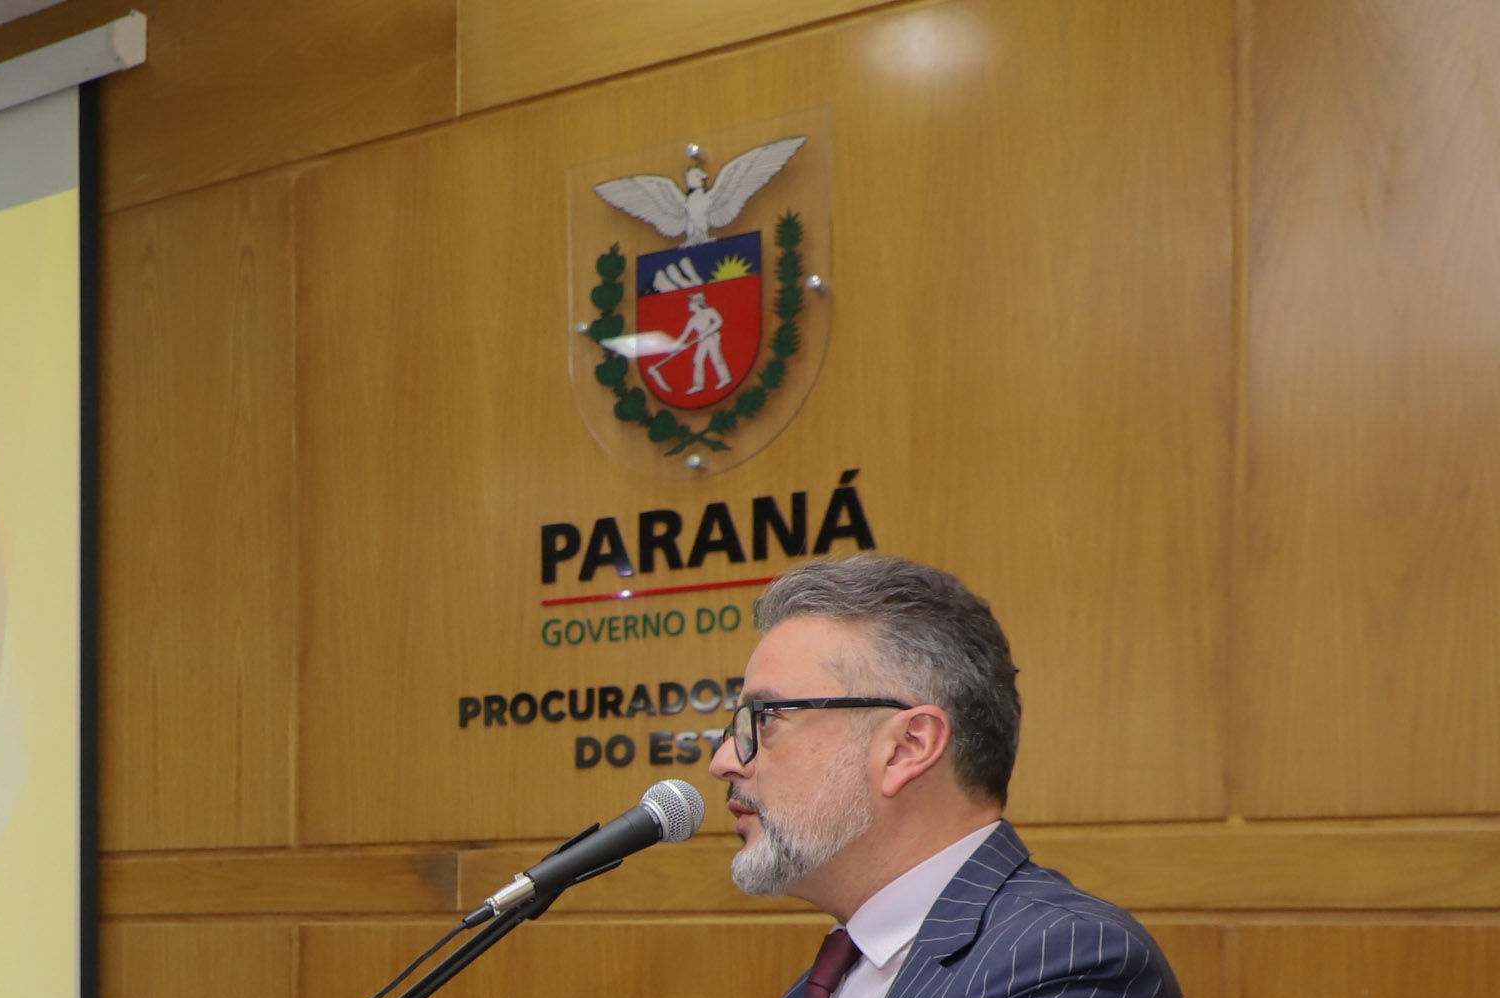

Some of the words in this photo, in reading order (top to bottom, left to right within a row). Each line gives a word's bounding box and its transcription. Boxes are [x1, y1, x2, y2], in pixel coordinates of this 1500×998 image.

[541, 468, 877, 584] PARANÁ
[541, 609, 686, 647] GOVERNO
[695, 604, 741, 634] DO
[457, 676, 745, 729] PROCURADOR
[575, 734, 636, 770] DO
[649, 728, 725, 767] EST
